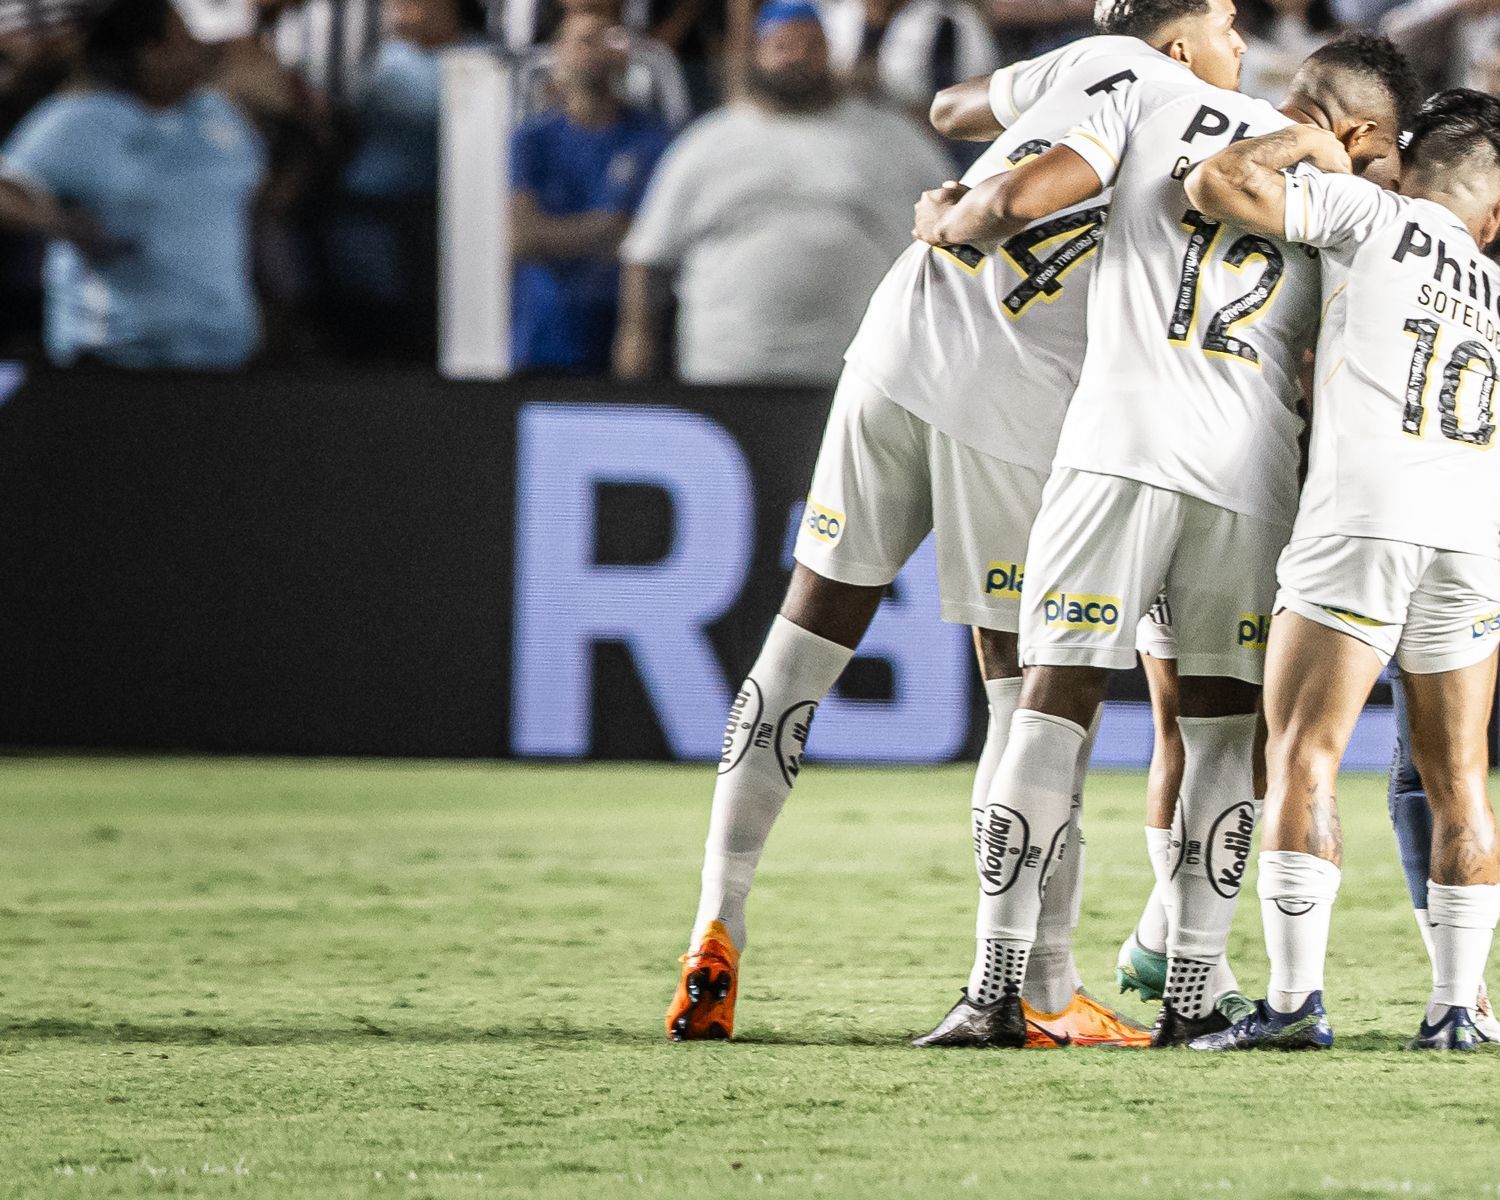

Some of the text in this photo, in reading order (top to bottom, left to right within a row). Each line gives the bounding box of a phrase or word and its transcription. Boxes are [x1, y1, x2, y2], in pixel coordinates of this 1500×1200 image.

[1167, 208, 1285, 368] 12
[1402, 318, 1500, 448] 10
[1043, 594, 1119, 625] placo
[982, 809, 1012, 886] Kodilar
[1219, 808, 1254, 888] Kodilar
